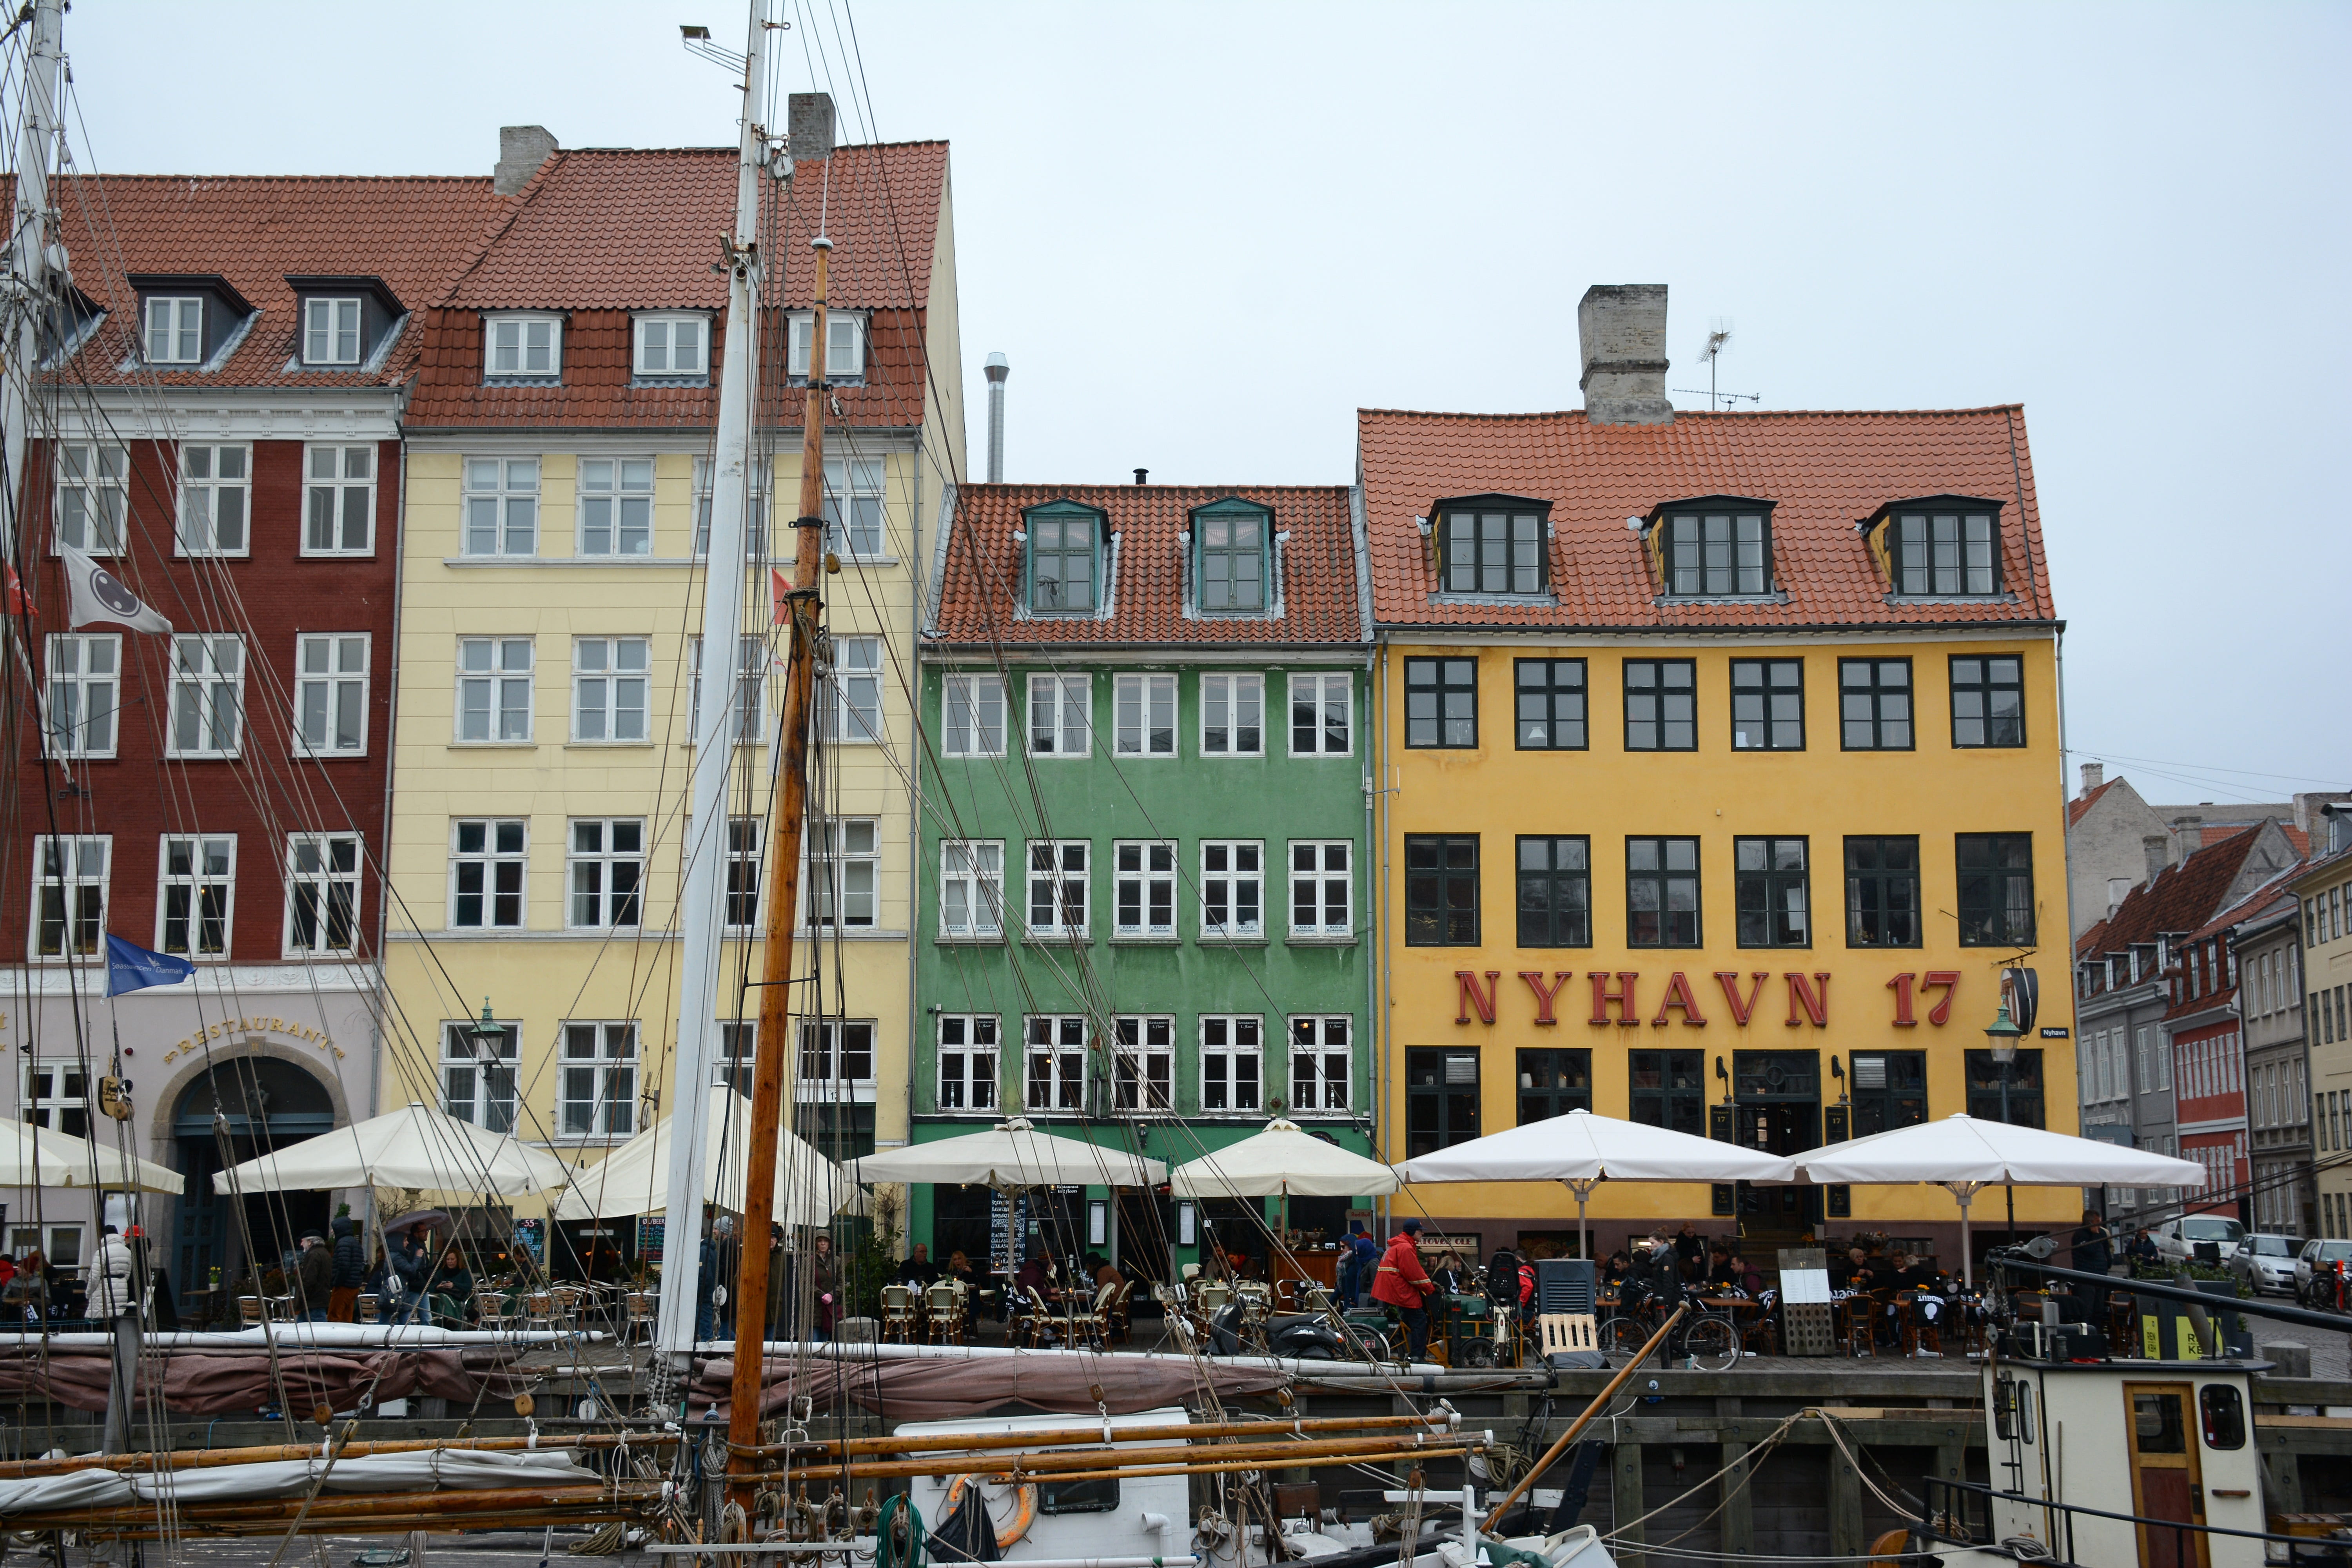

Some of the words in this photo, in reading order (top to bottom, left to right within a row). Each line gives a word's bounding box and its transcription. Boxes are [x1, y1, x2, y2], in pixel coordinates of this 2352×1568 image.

[1455, 971, 1831, 1024] NYHAVN
[1886, 971, 1962, 1025] 17
[177, 1017, 333, 1055] RESTAURANT
